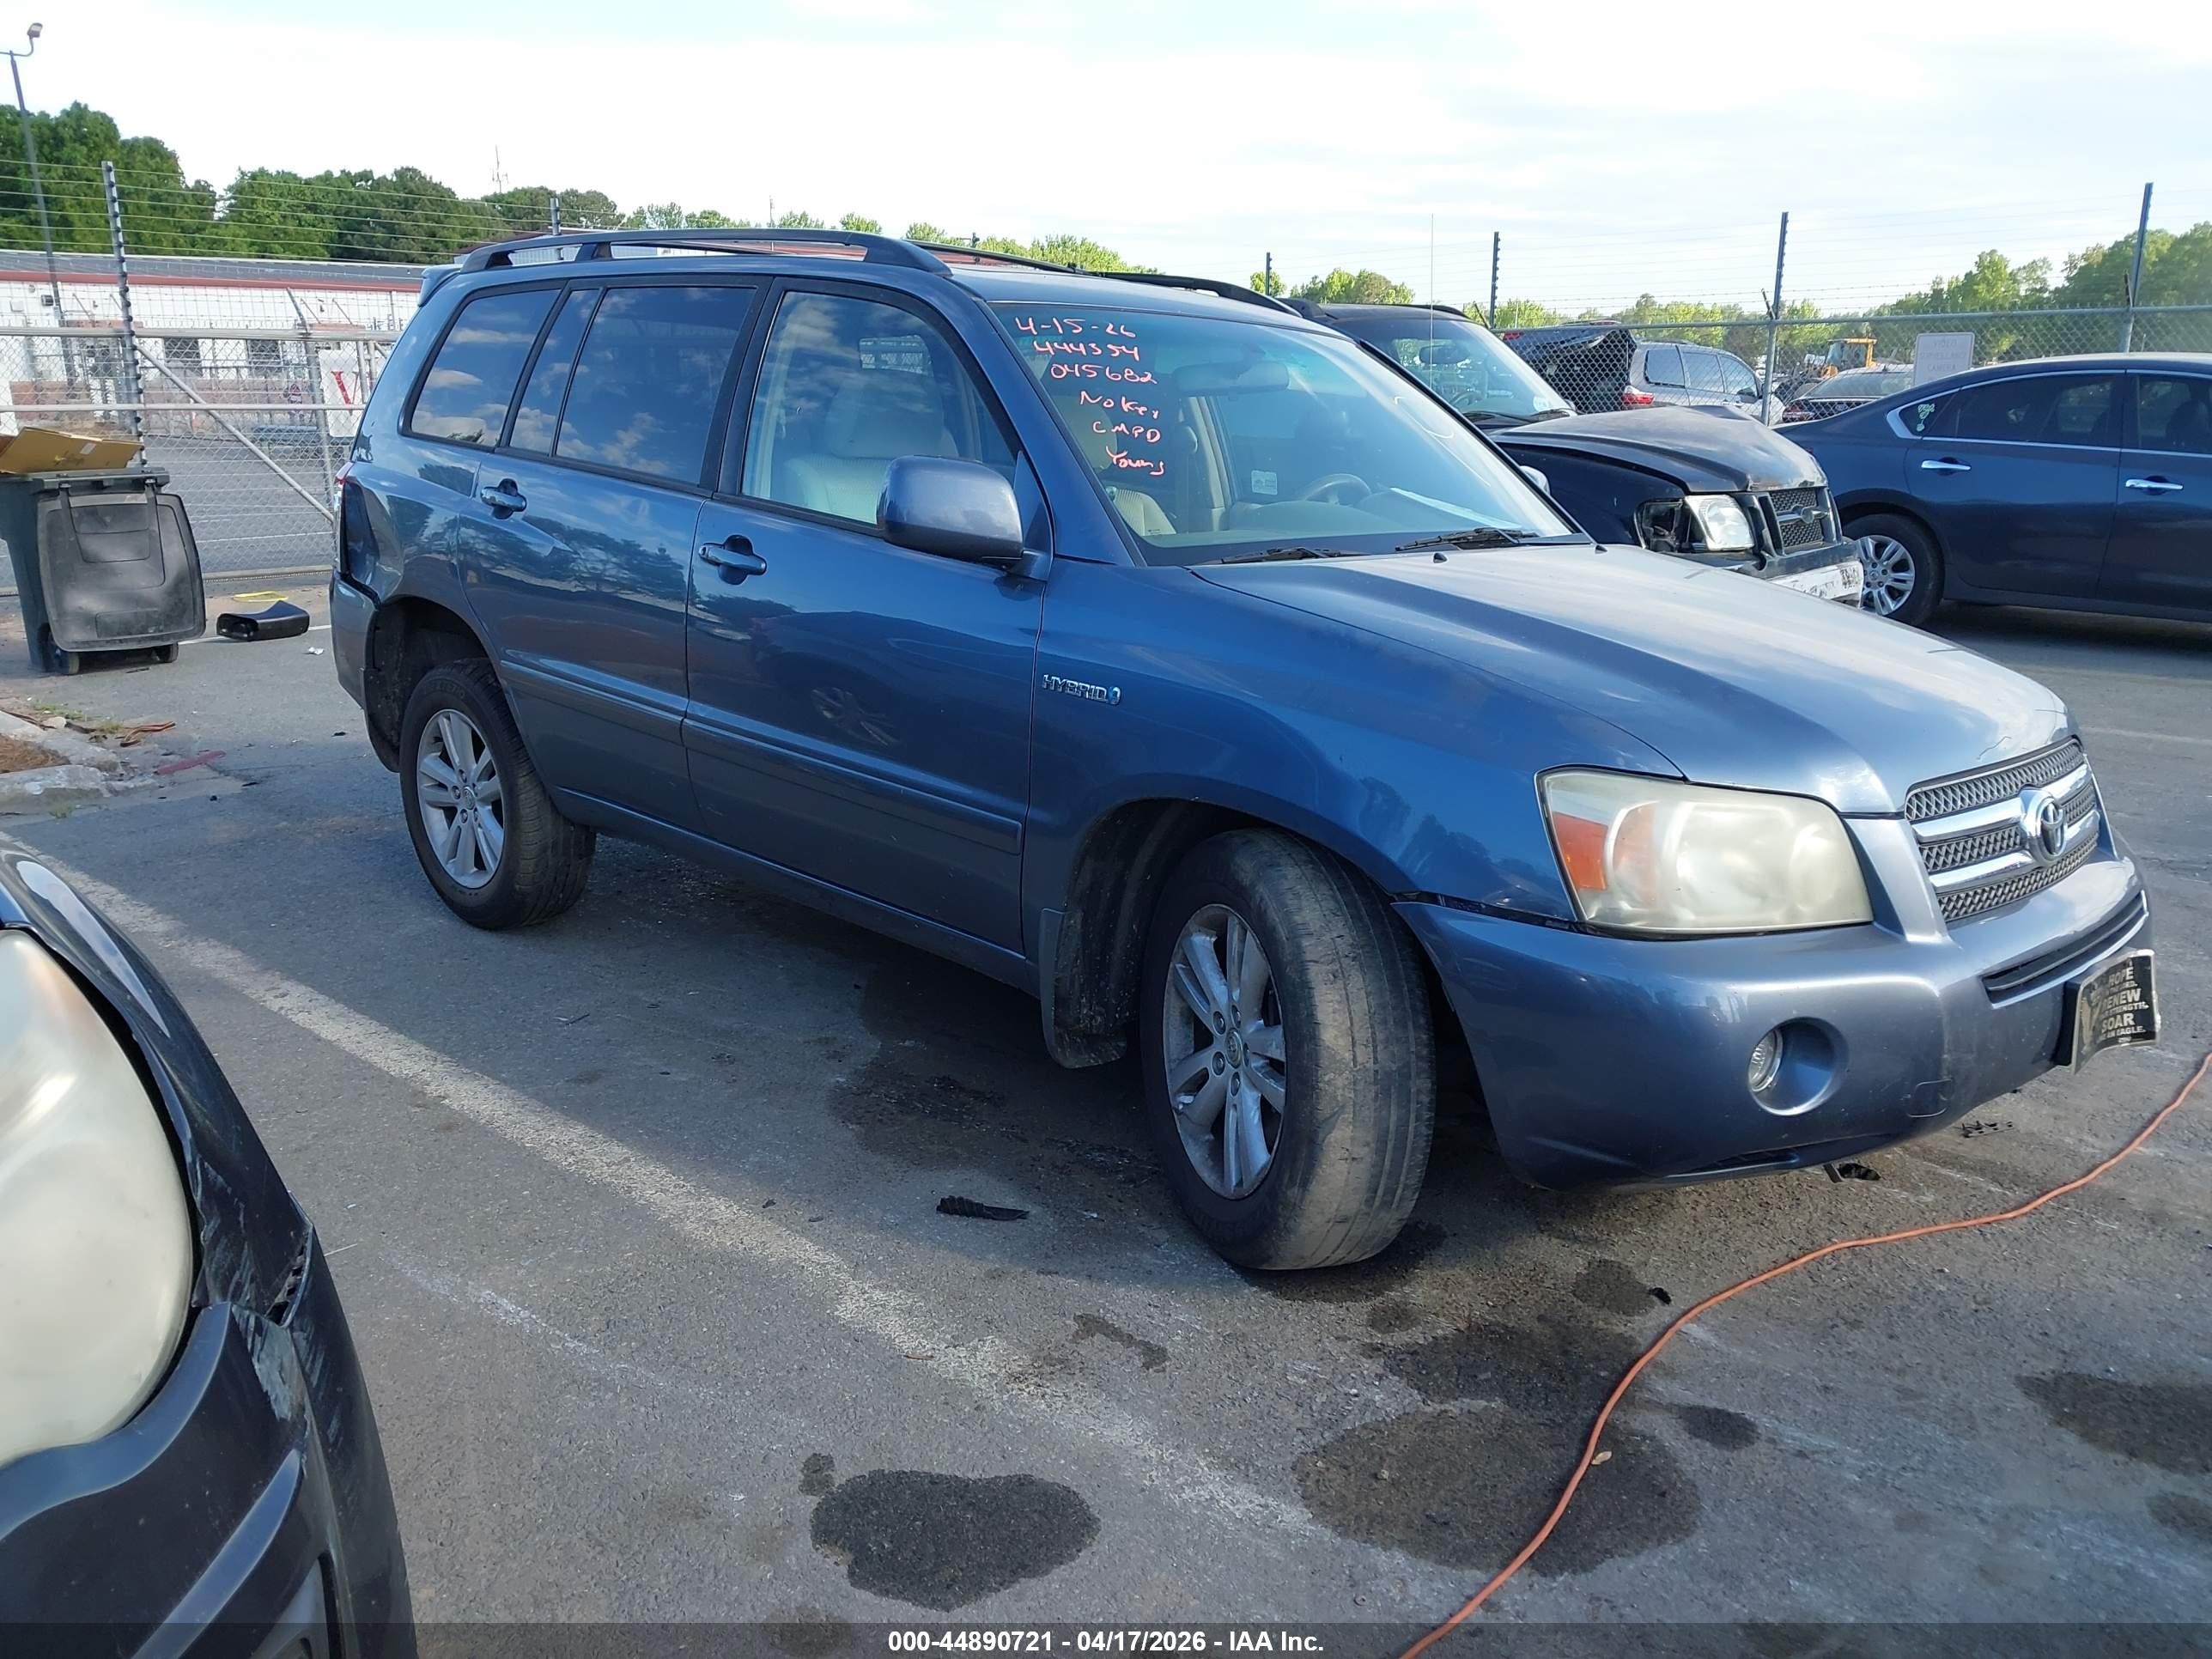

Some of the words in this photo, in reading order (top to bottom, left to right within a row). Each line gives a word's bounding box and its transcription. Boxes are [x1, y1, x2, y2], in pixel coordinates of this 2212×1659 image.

[1014, 316, 1137, 337] 4-15-26
[1032, 340, 1140, 362] 444354
[1050, 363, 1158, 385] 045682
[1091, 421, 1161, 443] CMPD
[1042, 674, 1109, 702] HYBRID
[2101, 1012, 2136, 1033] SOAR
